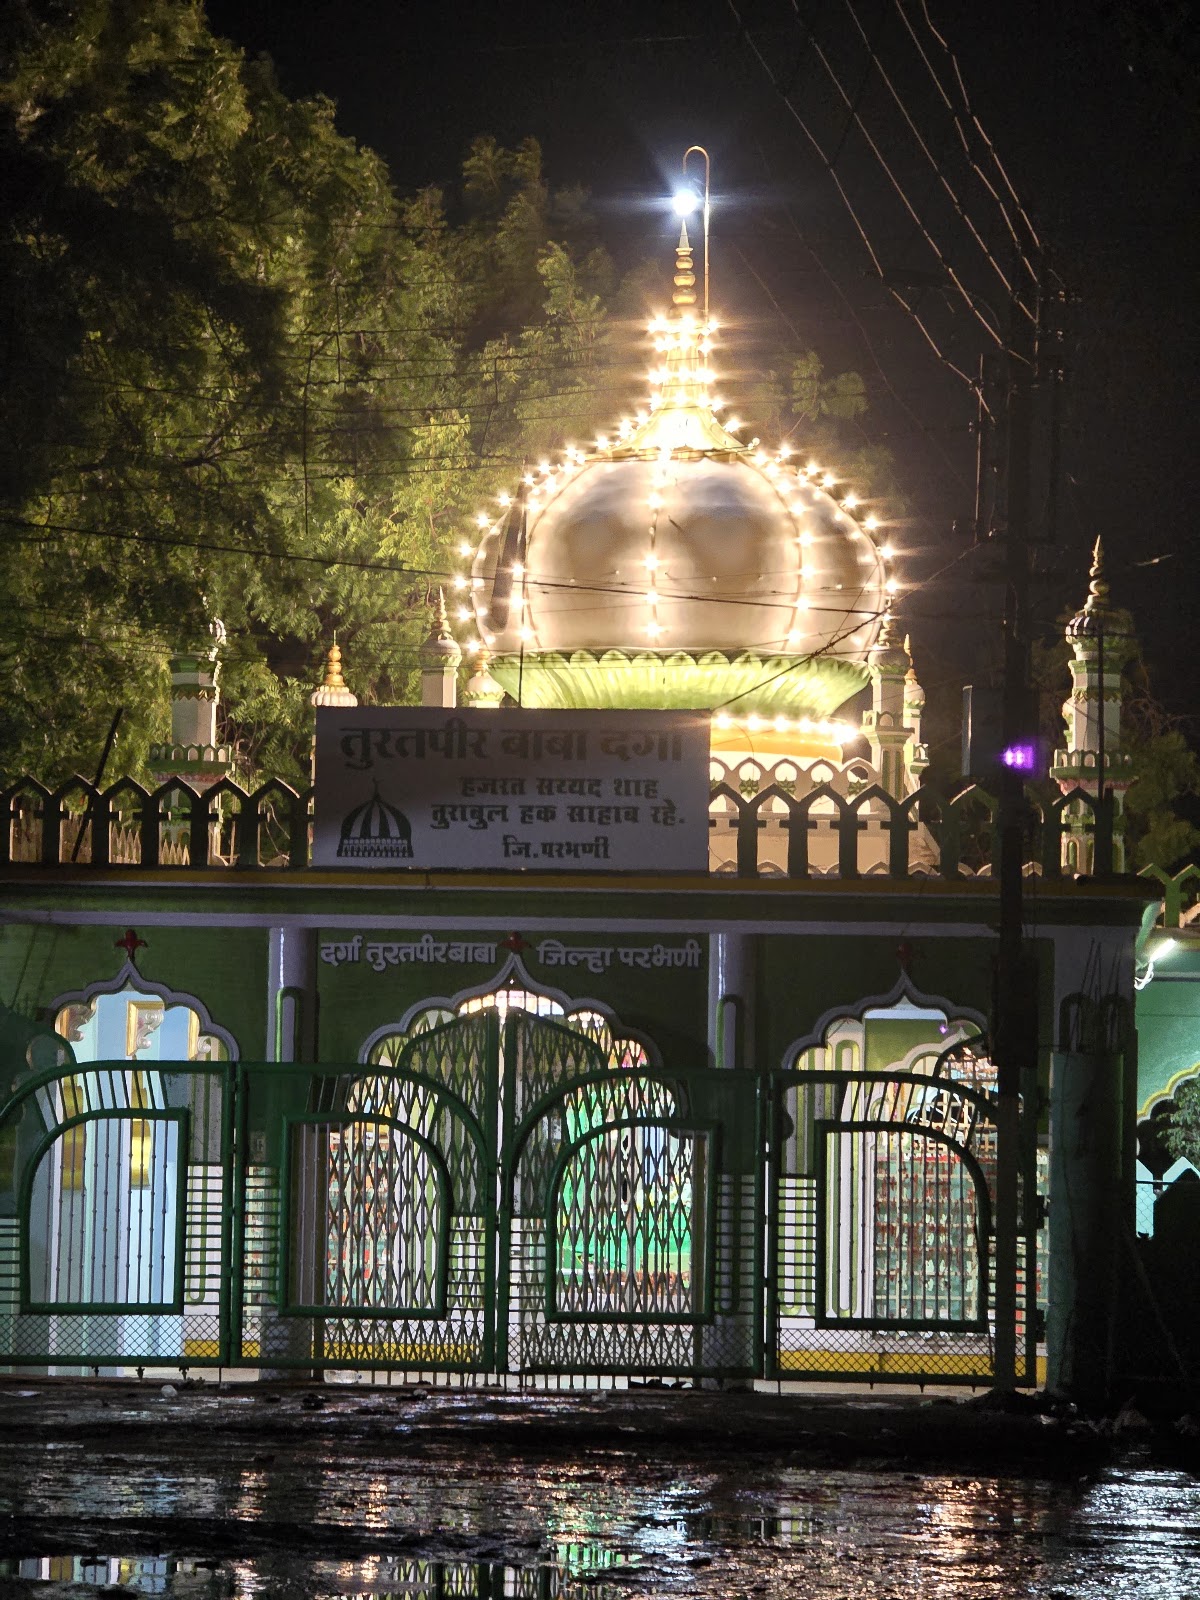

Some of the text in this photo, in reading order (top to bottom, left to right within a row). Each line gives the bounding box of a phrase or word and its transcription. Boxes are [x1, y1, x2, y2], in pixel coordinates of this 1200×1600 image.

[613, 778, 659, 799] शाह
[430, 804, 509, 830] तुराबुल
[518, 804, 558, 825] हक
[567, 804, 641, 826] साहाब
[320, 934, 363, 967] दर्गा
[536, 939, 615, 974] जिल्हा
[617, 939, 702, 968] परभणी
